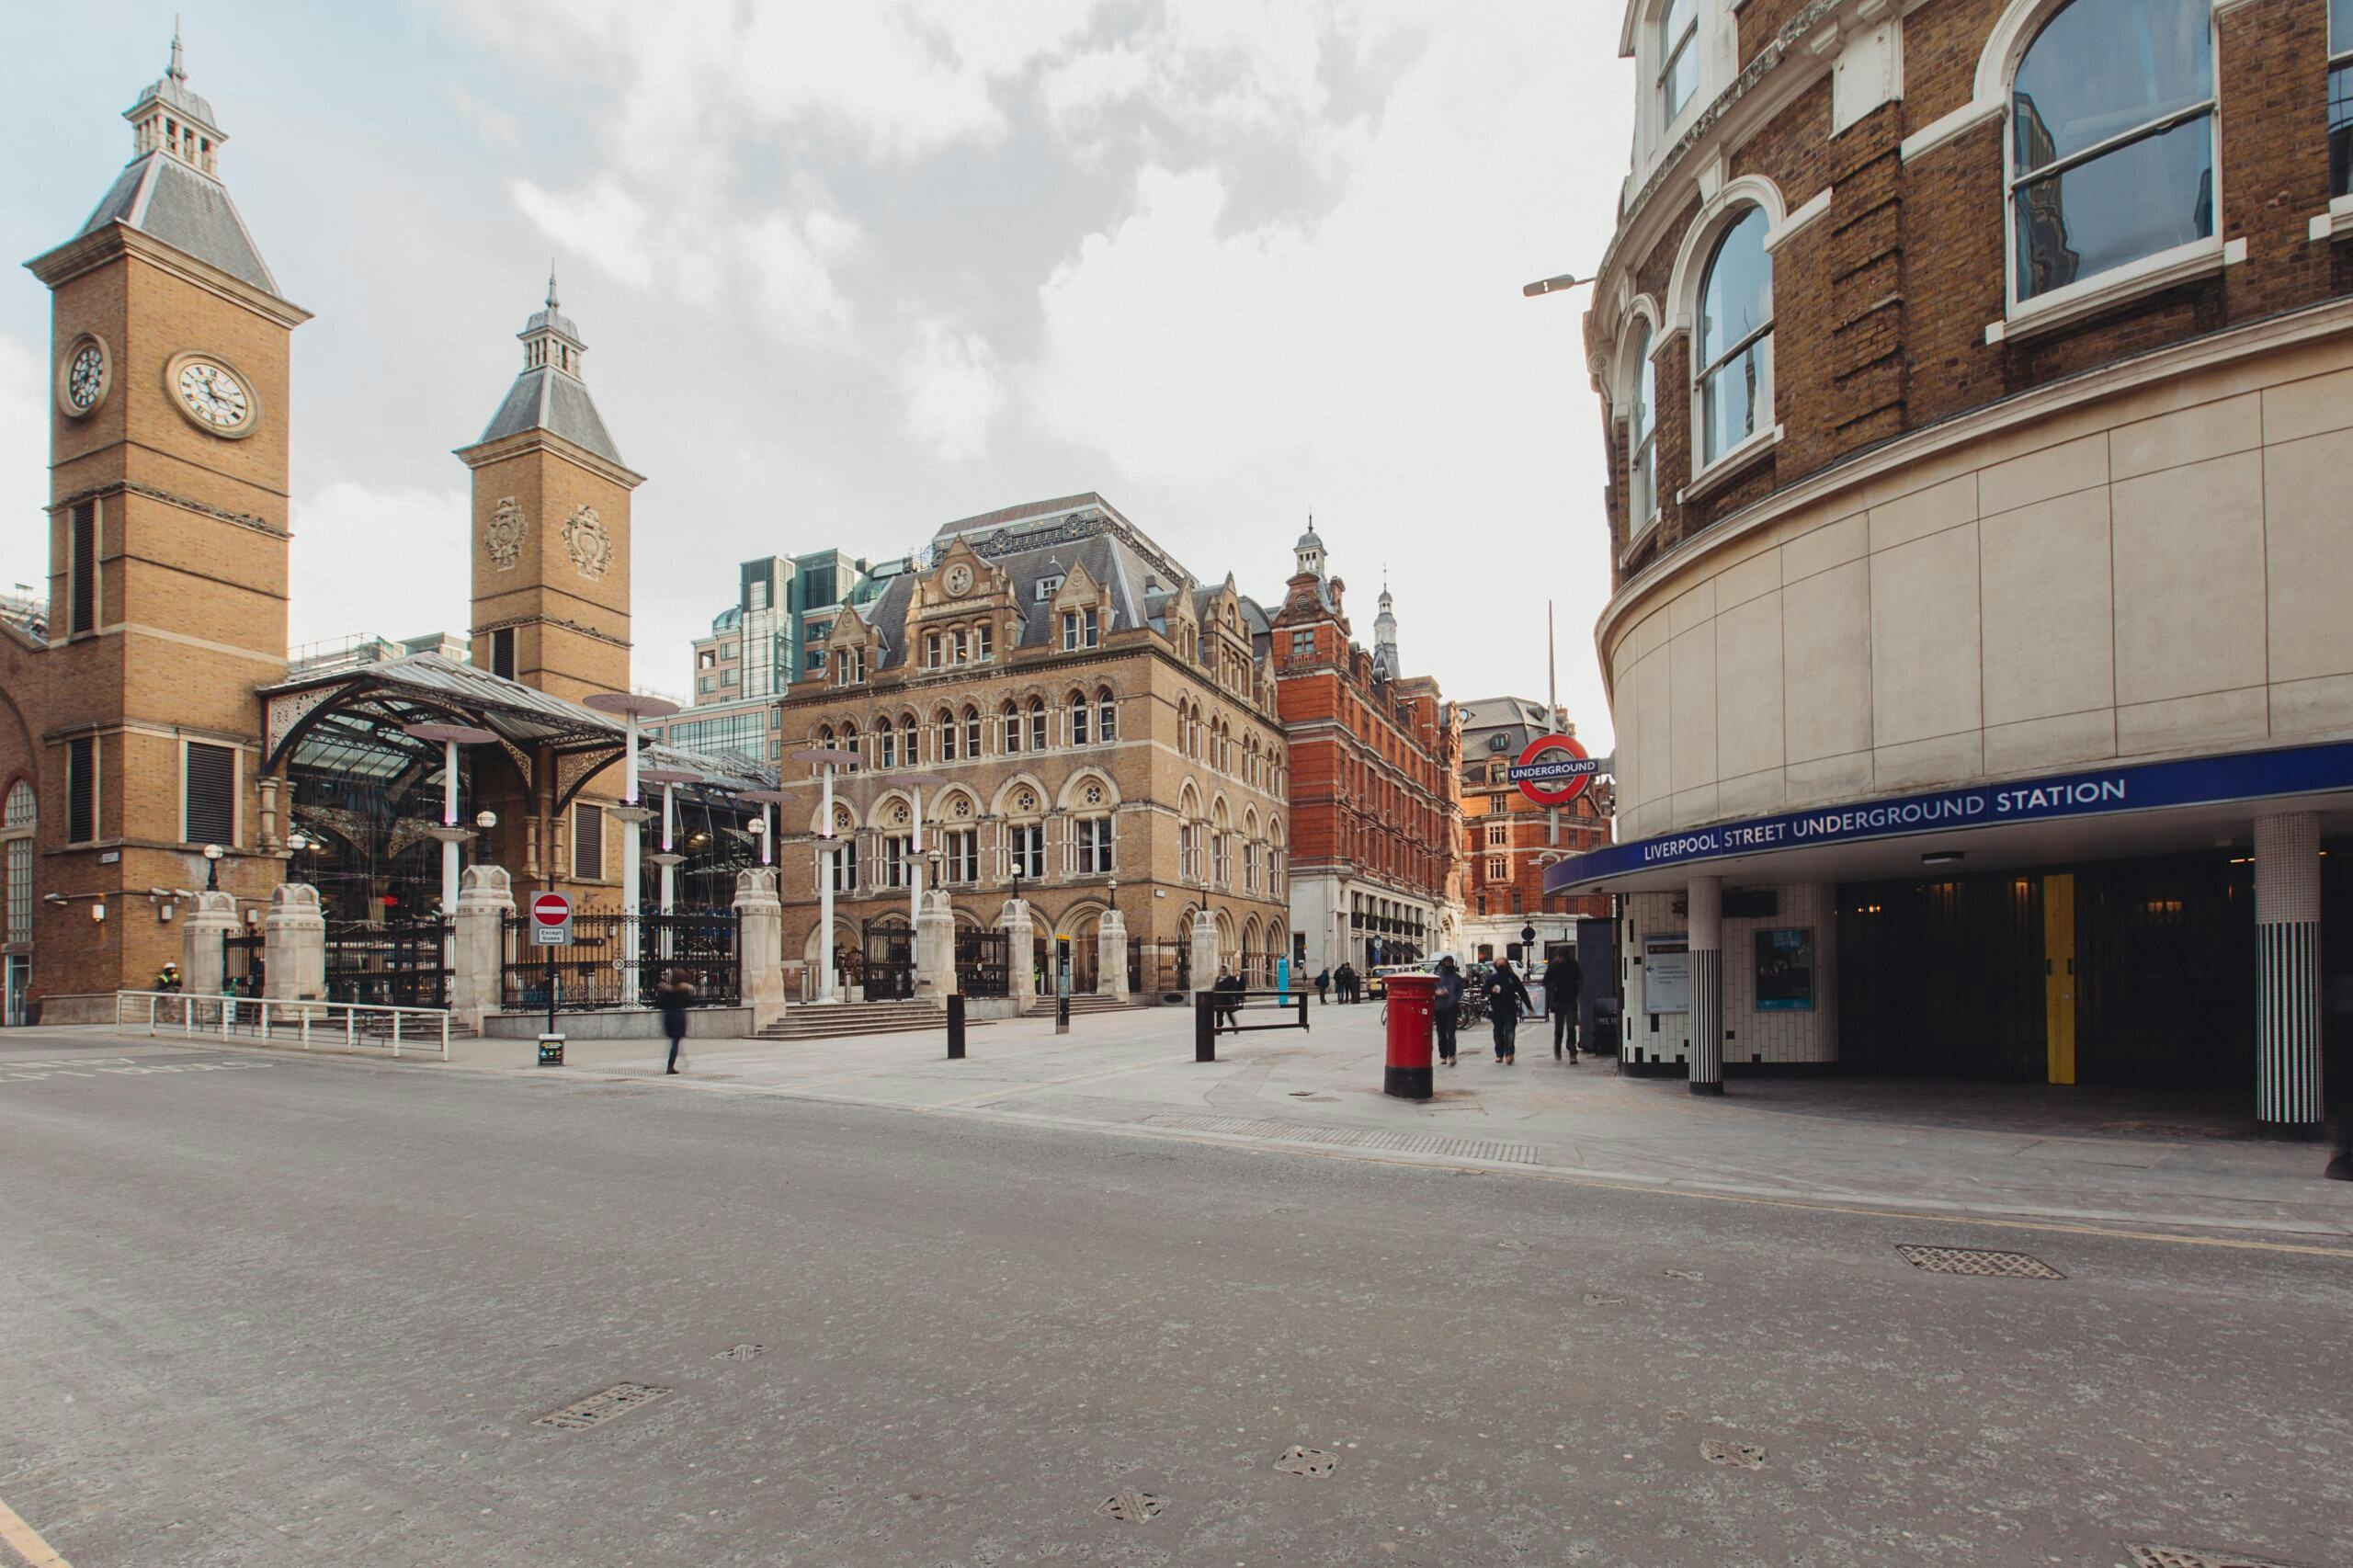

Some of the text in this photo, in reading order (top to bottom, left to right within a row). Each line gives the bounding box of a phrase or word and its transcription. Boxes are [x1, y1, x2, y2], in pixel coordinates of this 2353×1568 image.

[1511, 762, 1595, 778] UNDERGROUND
[1644, 779, 2125, 861] LIVERPOOL STREET UNDERGROUND STATION
